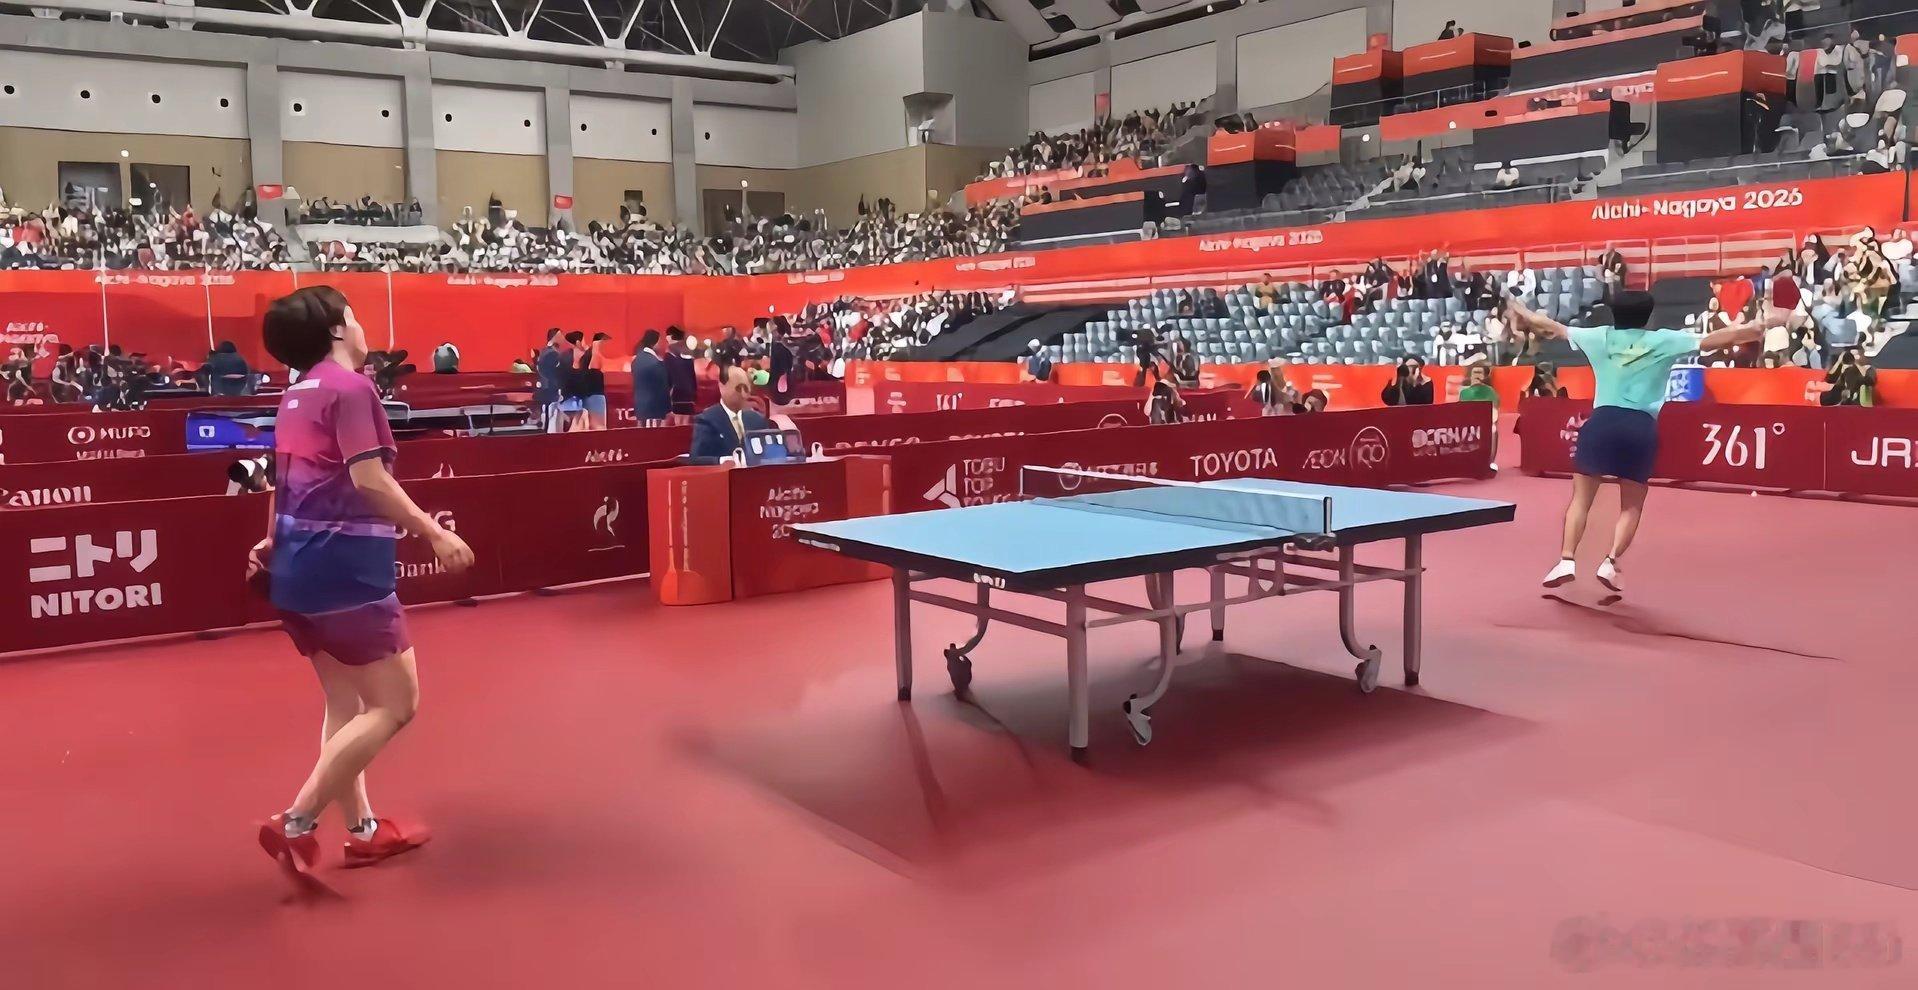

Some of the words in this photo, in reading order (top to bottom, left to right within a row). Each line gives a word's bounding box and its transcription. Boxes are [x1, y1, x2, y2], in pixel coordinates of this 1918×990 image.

[1742, 187, 1803, 210] 2026
[1189, 447, 1278, 477] TOYOTA
[1702, 422, 1786, 470] 361°
[29, 529, 158, 583] ニトリ
[30, 582, 162, 619] NITORI
